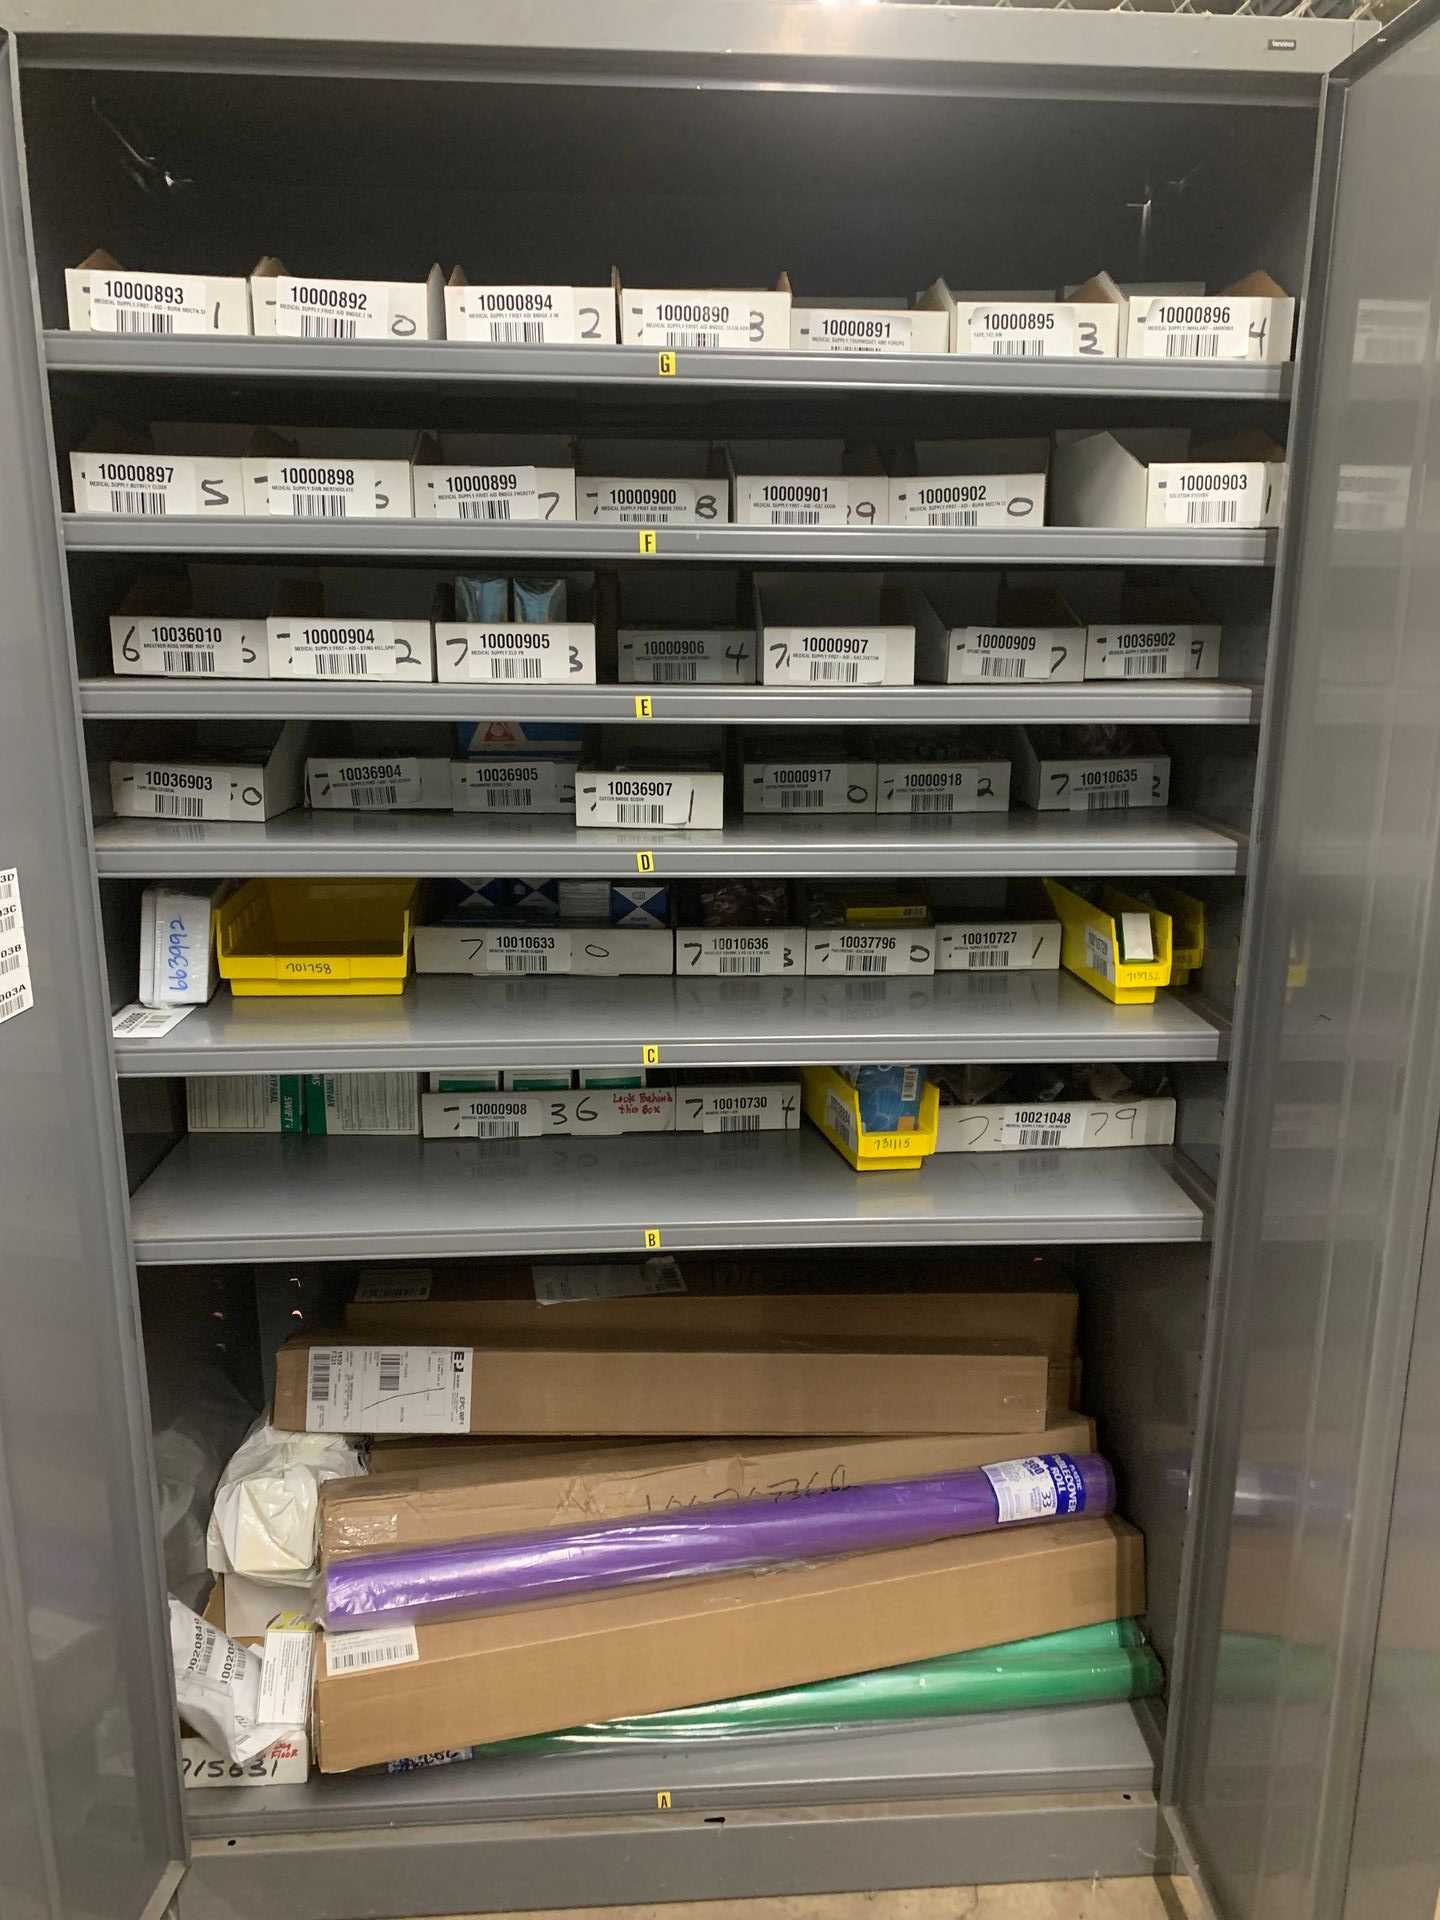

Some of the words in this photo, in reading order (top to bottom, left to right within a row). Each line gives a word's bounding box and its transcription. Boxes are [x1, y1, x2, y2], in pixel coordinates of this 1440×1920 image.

[104, 280, 184, 304] 10000893
[291, 286, 367, 310] 10000892
[478, 294, 552, 311] 10000894
[656, 304, 729, 322] 10000890
[1159, 306, 1230, 324] 10000896
[579, 308, 601, 338] 2
[822, 320, 892, 338] 10000891
[984, 314, 1054, 330] 10000895
[1078, 322, 1104, 355] 3
[1249, 318, 1267, 358] 4
[661, 354, 670, 373] G
[98, 464, 174, 482] 10000897
[281, 468, 354, 485] 10000898
[446, 474, 517, 492] 10000899
[1180, 474, 1248, 490] 10000903
[610, 489, 676, 504] 10000900
[762, 486, 828, 502] 10000901
[918, 486, 986, 504] 10000902
[695, 495, 718, 520] 8
[644, 534, 652, 552] F
[152, 627, 222, 642] 10036010
[303, 629, 374, 644] 10000904
[480, 634, 550, 649] 10000905
[976, 634, 1036, 650] 10000909
[1117, 632, 1176, 648] 10036902
[122, 626, 140, 662] 6
[394, 638, 422, 664] 2
[446, 638, 468, 667] 7
[644, 640, 704, 655] 10000906
[802, 637, 868, 654] 10000907
[726, 642, 750, 675] 4
[641, 699, 650, 716] E
[145, 771, 212, 790] 10036903
[339, 764, 401, 781] 10036904
[476, 768, 538, 782] 10036905
[774, 770, 832, 783] 10000917
[904, 774, 962, 786] 10000918
[1080, 769, 1137, 785] 10010635
[608, 782, 672, 796] 10036907
[1051, 774, 1069, 795] 7
[641, 854, 650, 870] D
[496, 936, 554, 948] 10010633
[712, 938, 768, 950] 10010636
[840, 936, 896, 949] 10037796
[962, 932, 1016, 945] 10010727
[460, 939, 483, 960] 7
[684, 943, 702, 966] 7
[648, 1048, 654, 1063] C
[470, 1104, 527, 1115] 10000908
[552, 1096, 598, 1125] 36
[642, 1104, 660, 1114] Box
[686, 1099, 703, 1118] 7
[713, 1097, 768, 1109] 10010730
[1015, 1111, 1072, 1124] 10021048
[959, 1116, 990, 1144] 7
[649, 1234, 655, 1246] B
[1050, 1467, 1066, 1494] ROLL
[1041, 1491, 1051, 1508] 33
[661, 1795, 668, 1808] A
